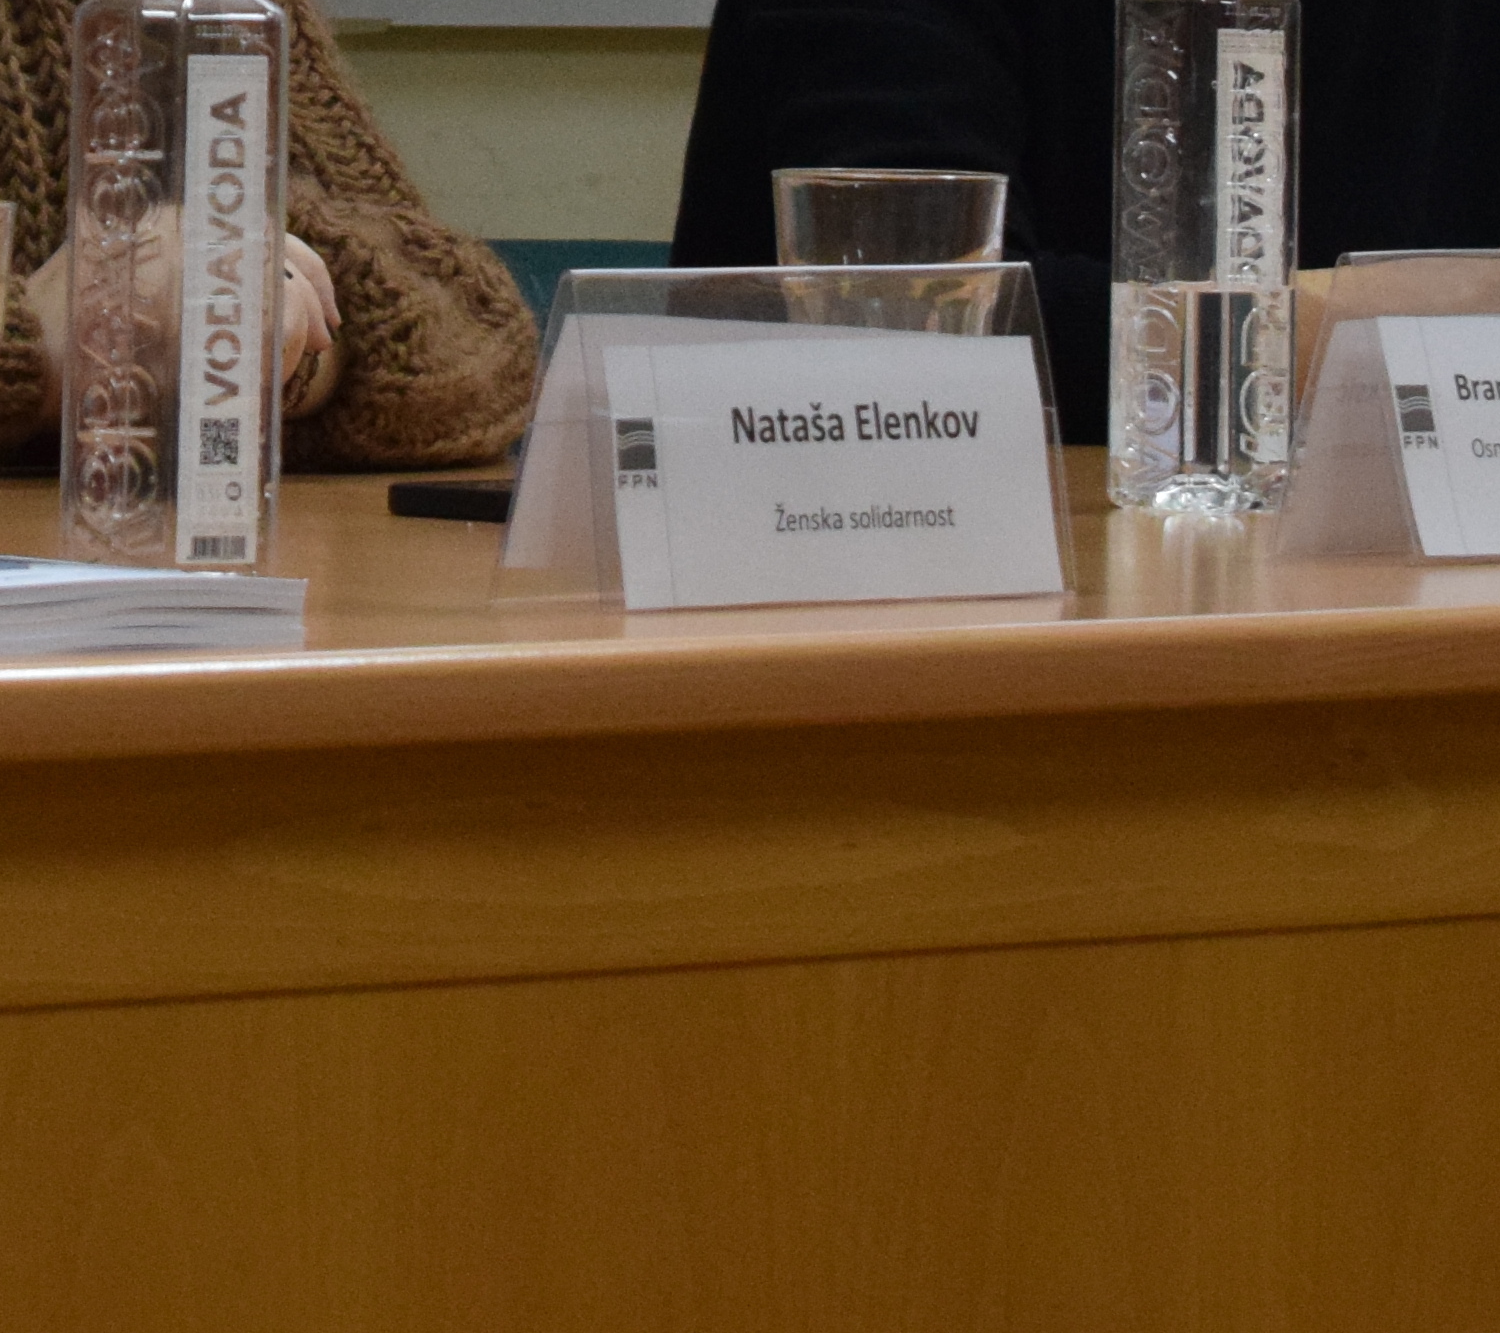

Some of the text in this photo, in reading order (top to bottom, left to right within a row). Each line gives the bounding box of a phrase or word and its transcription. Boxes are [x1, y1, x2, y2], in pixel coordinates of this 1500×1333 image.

[204, 91, 248, 407] VODAVODA
[731, 400, 980, 444] Nataša Elenkov
[1403, 436, 1439, 450] FPN
[618, 473, 658, 488] FPN
[774, 502, 955, 533] Ženska solidarnost
